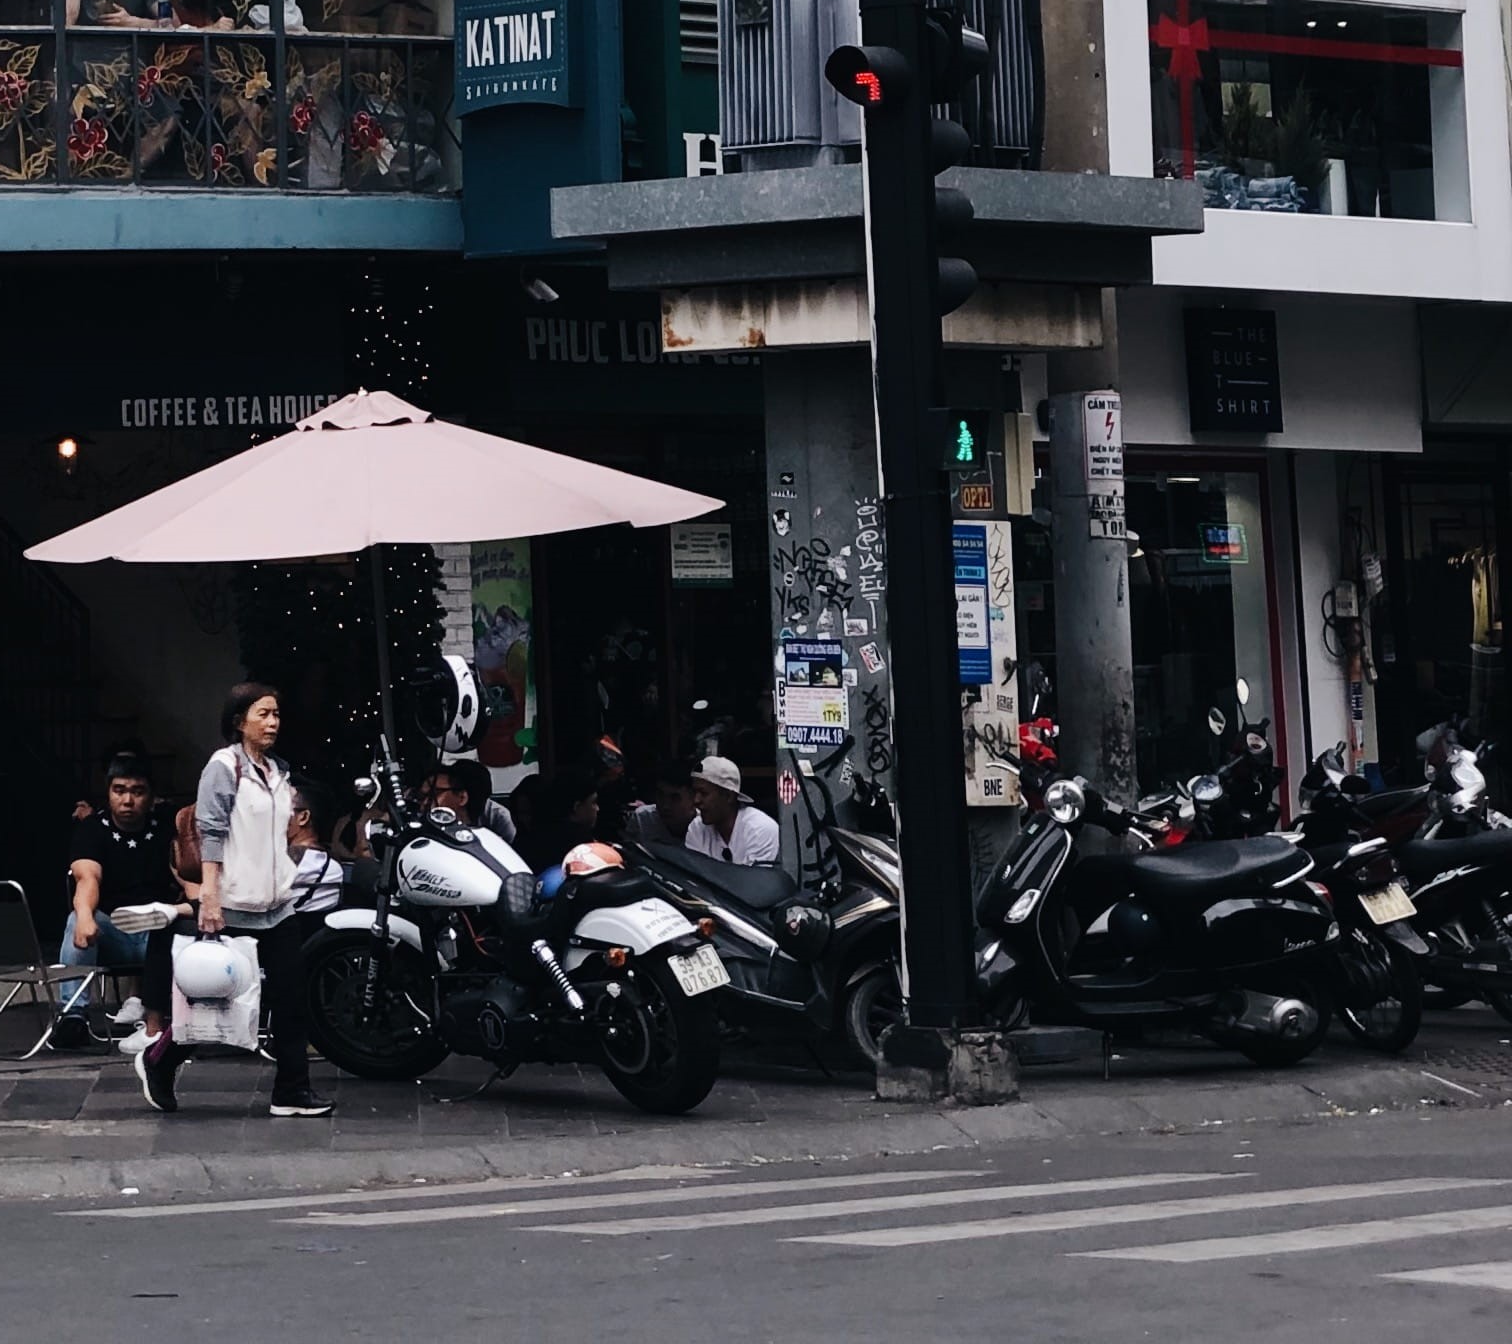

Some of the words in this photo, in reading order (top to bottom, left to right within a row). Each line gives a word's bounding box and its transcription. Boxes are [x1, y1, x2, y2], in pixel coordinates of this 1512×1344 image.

[466, 10, 556, 68] KATINAT
[1237, 327, 1266, 344] THE
[121, 396, 198, 428] COFFEE
[203, 395, 220, 427] &
[224, 394, 264, 425] TEA
[1216, 397, 1270, 415] SHIRT
[983, 778, 1003, 797] BNE
